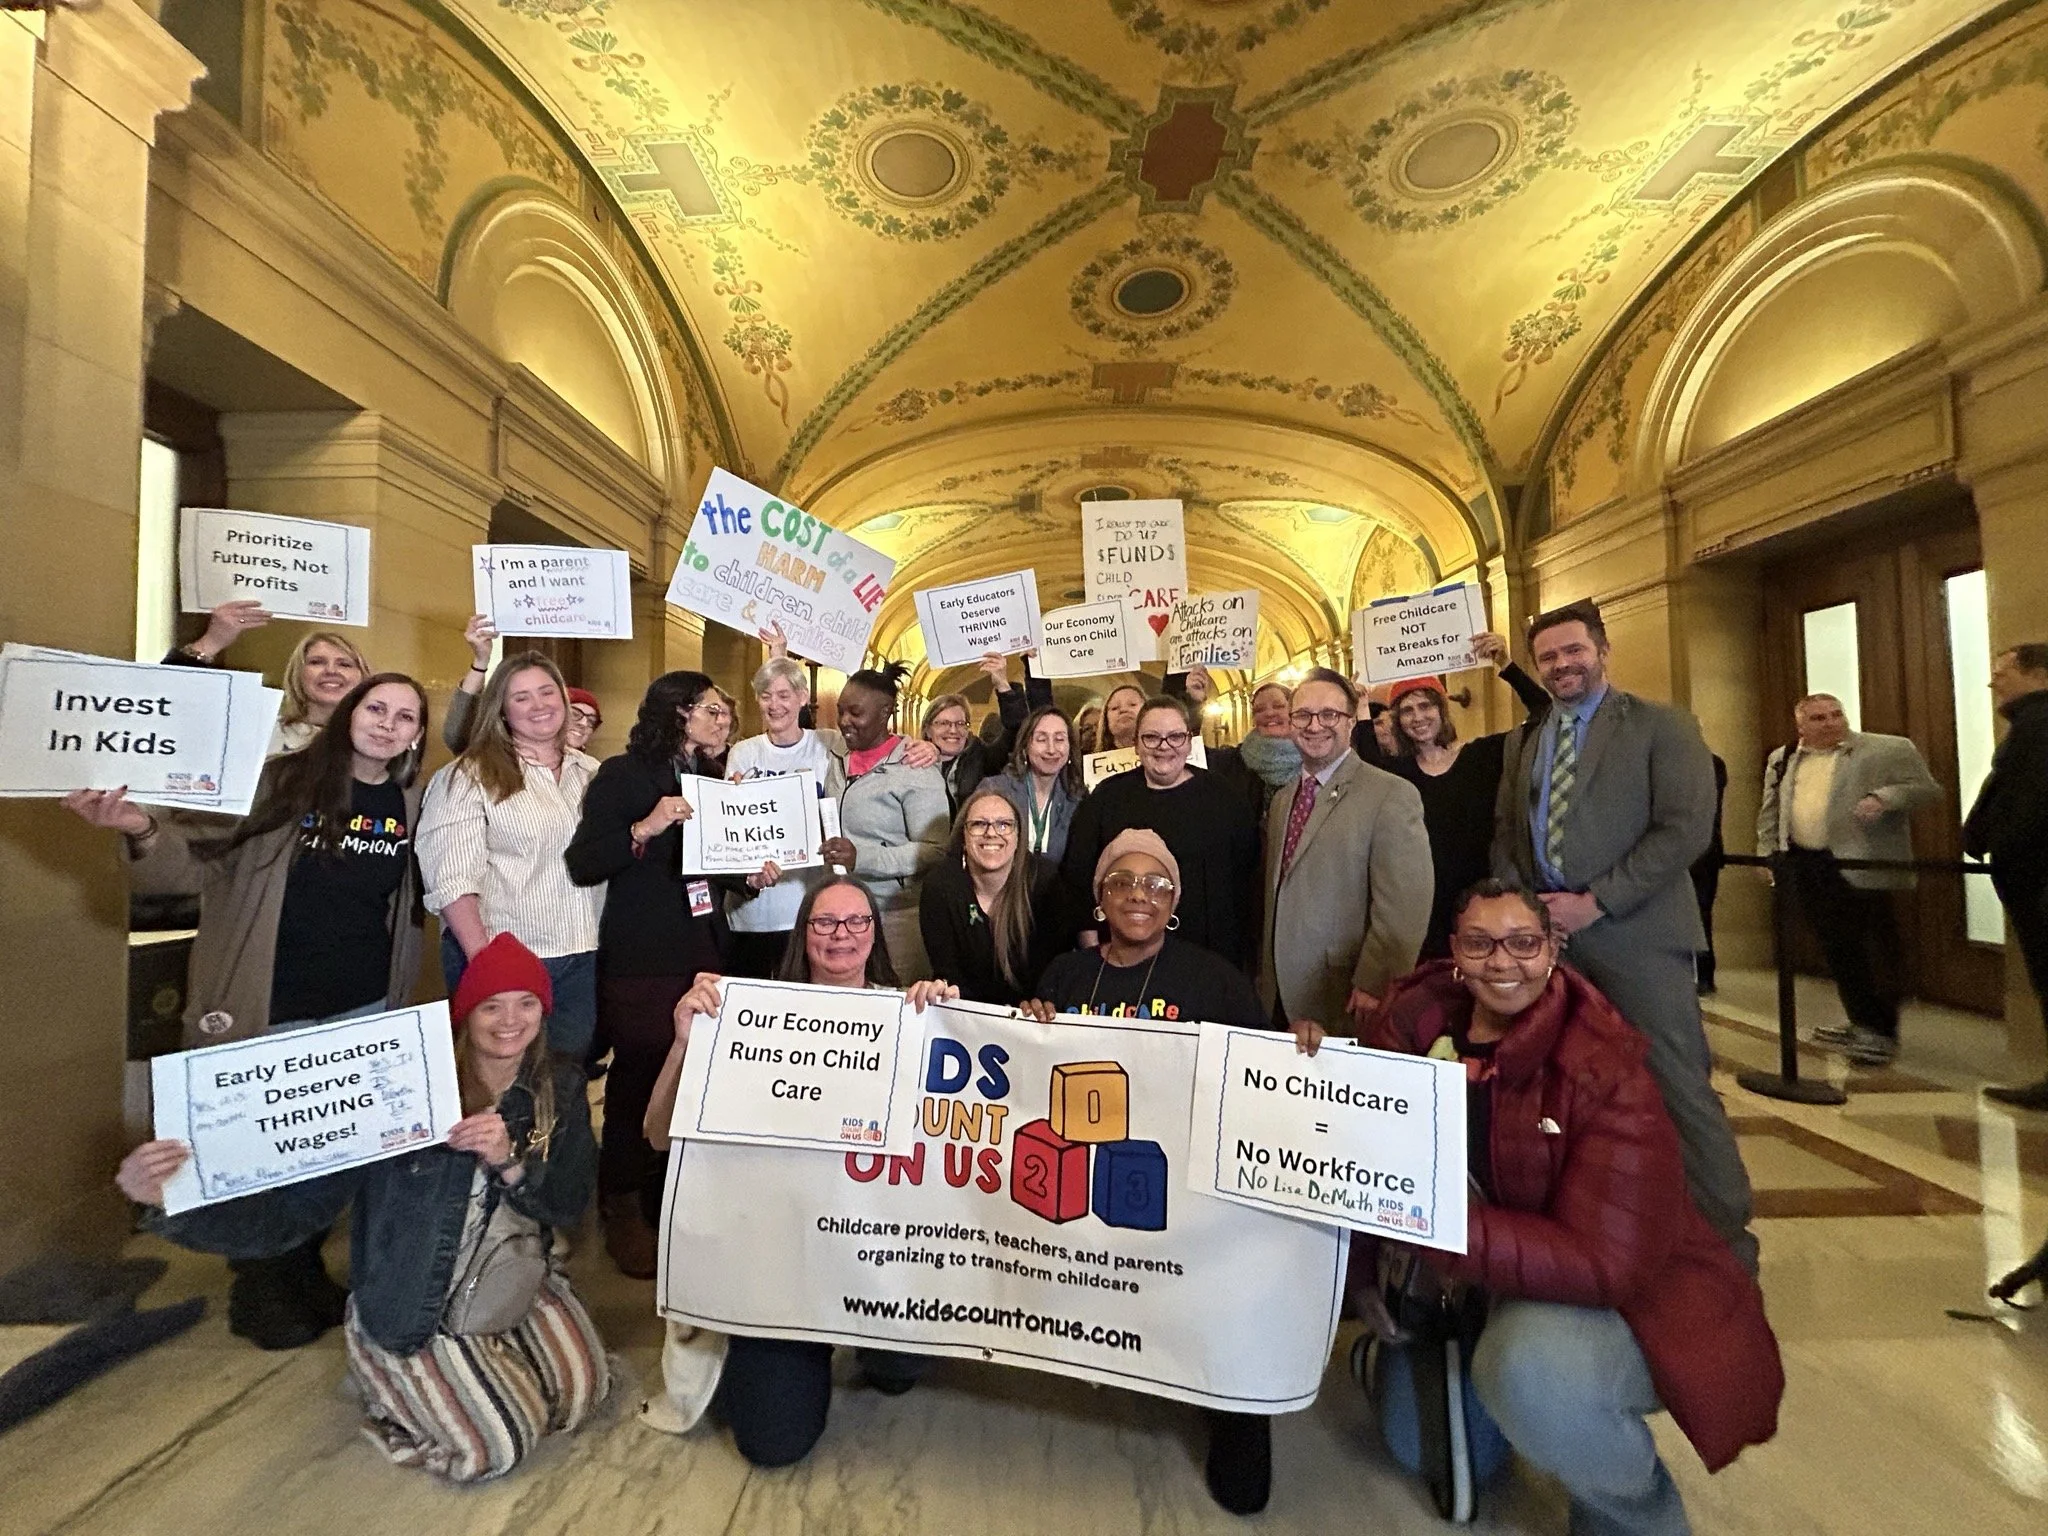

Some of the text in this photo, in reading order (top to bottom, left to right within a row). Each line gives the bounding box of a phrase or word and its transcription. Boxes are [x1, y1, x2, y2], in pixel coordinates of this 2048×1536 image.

[1095, 517, 1104, 531] I
[227, 530, 313, 552] Prioritize
[1114, 530, 1133, 542] DO
[212, 550, 329, 575] Futures, Not
[501, 556, 589, 571] I'm a parent
[701, 493, 886, 614] the COST of a LIE
[756, 541, 827, 594] HARM
[1097, 571, 1133, 585] CHILD
[233, 573, 299, 592] Profits
[508, 575, 586, 589] and I want
[683, 540, 709, 573] to
[820, 610, 871, 646] child
[537, 594, 567, 606] free
[676, 576, 733, 612] care
[740, 599, 757, 626] &
[940, 587, 1016, 610] Early Educators
[1171, 596, 1244, 624] Attacks on
[525, 613, 587, 626] childcare
[961, 605, 1000, 620] Deserve
[1045, 614, 1116, 632] Our Economy
[1373, 601, 1457, 626] Free Childcare
[959, 617, 1007, 634] THRIVING
[1169, 625, 1252, 645] are attacks on
[1401, 623, 1426, 635] NOT
[967, 632, 1002, 647] Wages!
[1045, 628, 1118, 647] Runs on Child
[1376, 633, 1460, 656] Tax Breaks for
[1069, 648, 1094, 658] Care
[1179, 643, 1241, 667] Families
[1396, 652, 1444, 668] Amazon
[54, 690, 172, 717] Invest
[48, 729, 177, 756] In Kids
[720, 799, 778, 817] Invest
[725, 825, 785, 842] In Kids
[737, 1009, 884, 1043] Our Economy
[215, 1064, 277, 1089] Early
[284, 1038, 400, 1074] Educators
[729, 1041, 881, 1071] Runs on Child
[925, 1037, 1010, 1101] DS
[264, 1072, 362, 1105] Deserve
[771, 1079, 822, 1101] Care
[1243, 1068, 1409, 1115] No Childcare
[255, 1092, 374, 1134] THRIVING
[842, 1117, 864, 1127] KIDS
[914, 1096, 1009, 1146] UNT
[274, 1122, 359, 1155] Wages!
[840, 1132, 862, 1141] ON US
[1315, 1122, 1328, 1133] =
[844, 1142, 1003, 1194] ON US
[1023, 1154, 1048, 1199] 2
[1236, 1139, 1415, 1195] No Workforce
[1125, 1170, 1150, 1212] 3
[1237, 1165, 1267, 1190] No
[1274, 1175, 1303, 1196] Lisa
[1378, 1197, 1404, 1211] KIDS
[1377, 1215, 1403, 1227] ON US
[816, 1216, 1184, 1277] Childcare providers, teachers, and parents
[857, 1248, 1139, 1294] organizing to transform childcare
[843, 1296, 1142, 1352] www.kidscountonus.com
